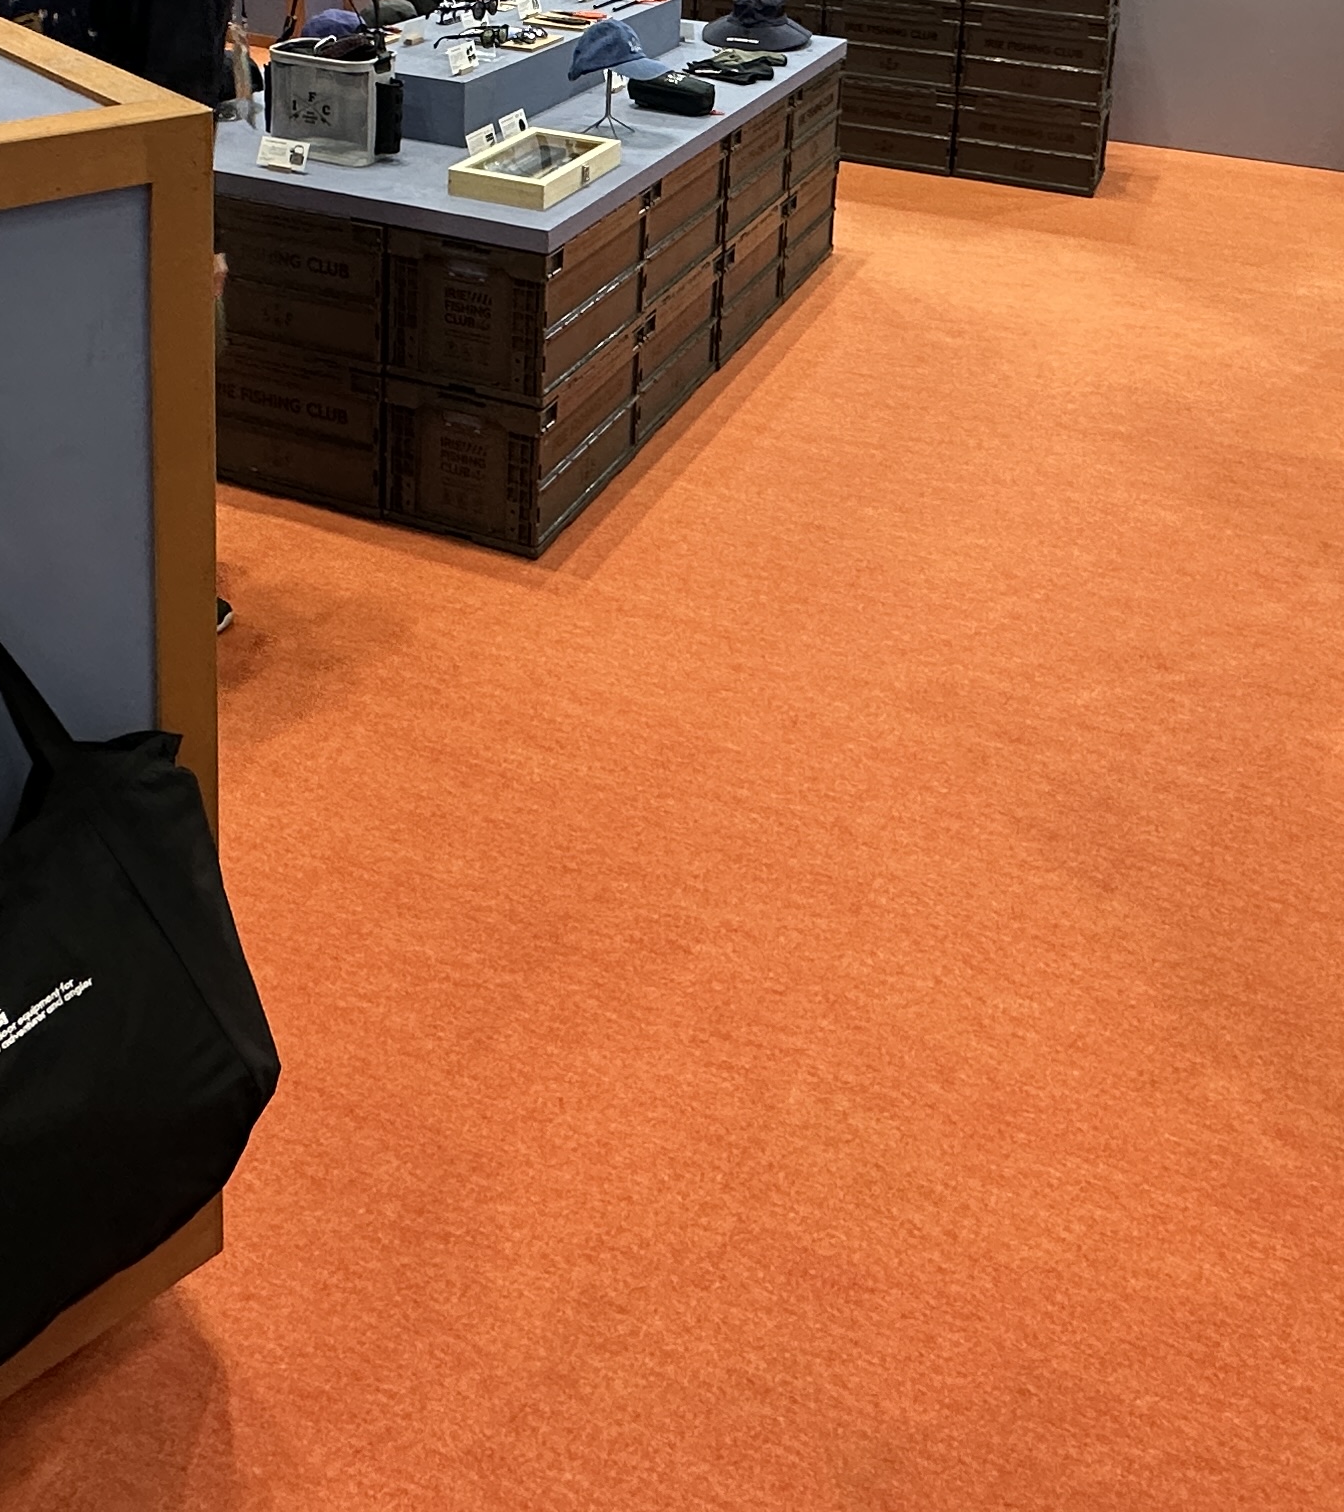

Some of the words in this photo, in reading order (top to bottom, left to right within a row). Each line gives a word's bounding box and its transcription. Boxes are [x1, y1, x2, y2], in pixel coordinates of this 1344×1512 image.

[308, 92, 316, 102] F
[322, 105, 331, 116] C
[307, 258, 350, 279] CLUB
[444, 300, 491, 320] FISHING
[444, 313, 475, 328] CLUB
[241, 386, 301, 413] FISHING
[306, 403, 348, 425] CLUB
[17, 987, 60, 1025] equipment
[59, 978, 74, 992] for
[1, 1011, 46, 1050] adventurer
[46, 995, 63, 1014] and
[63, 977, 93, 1002] angler
